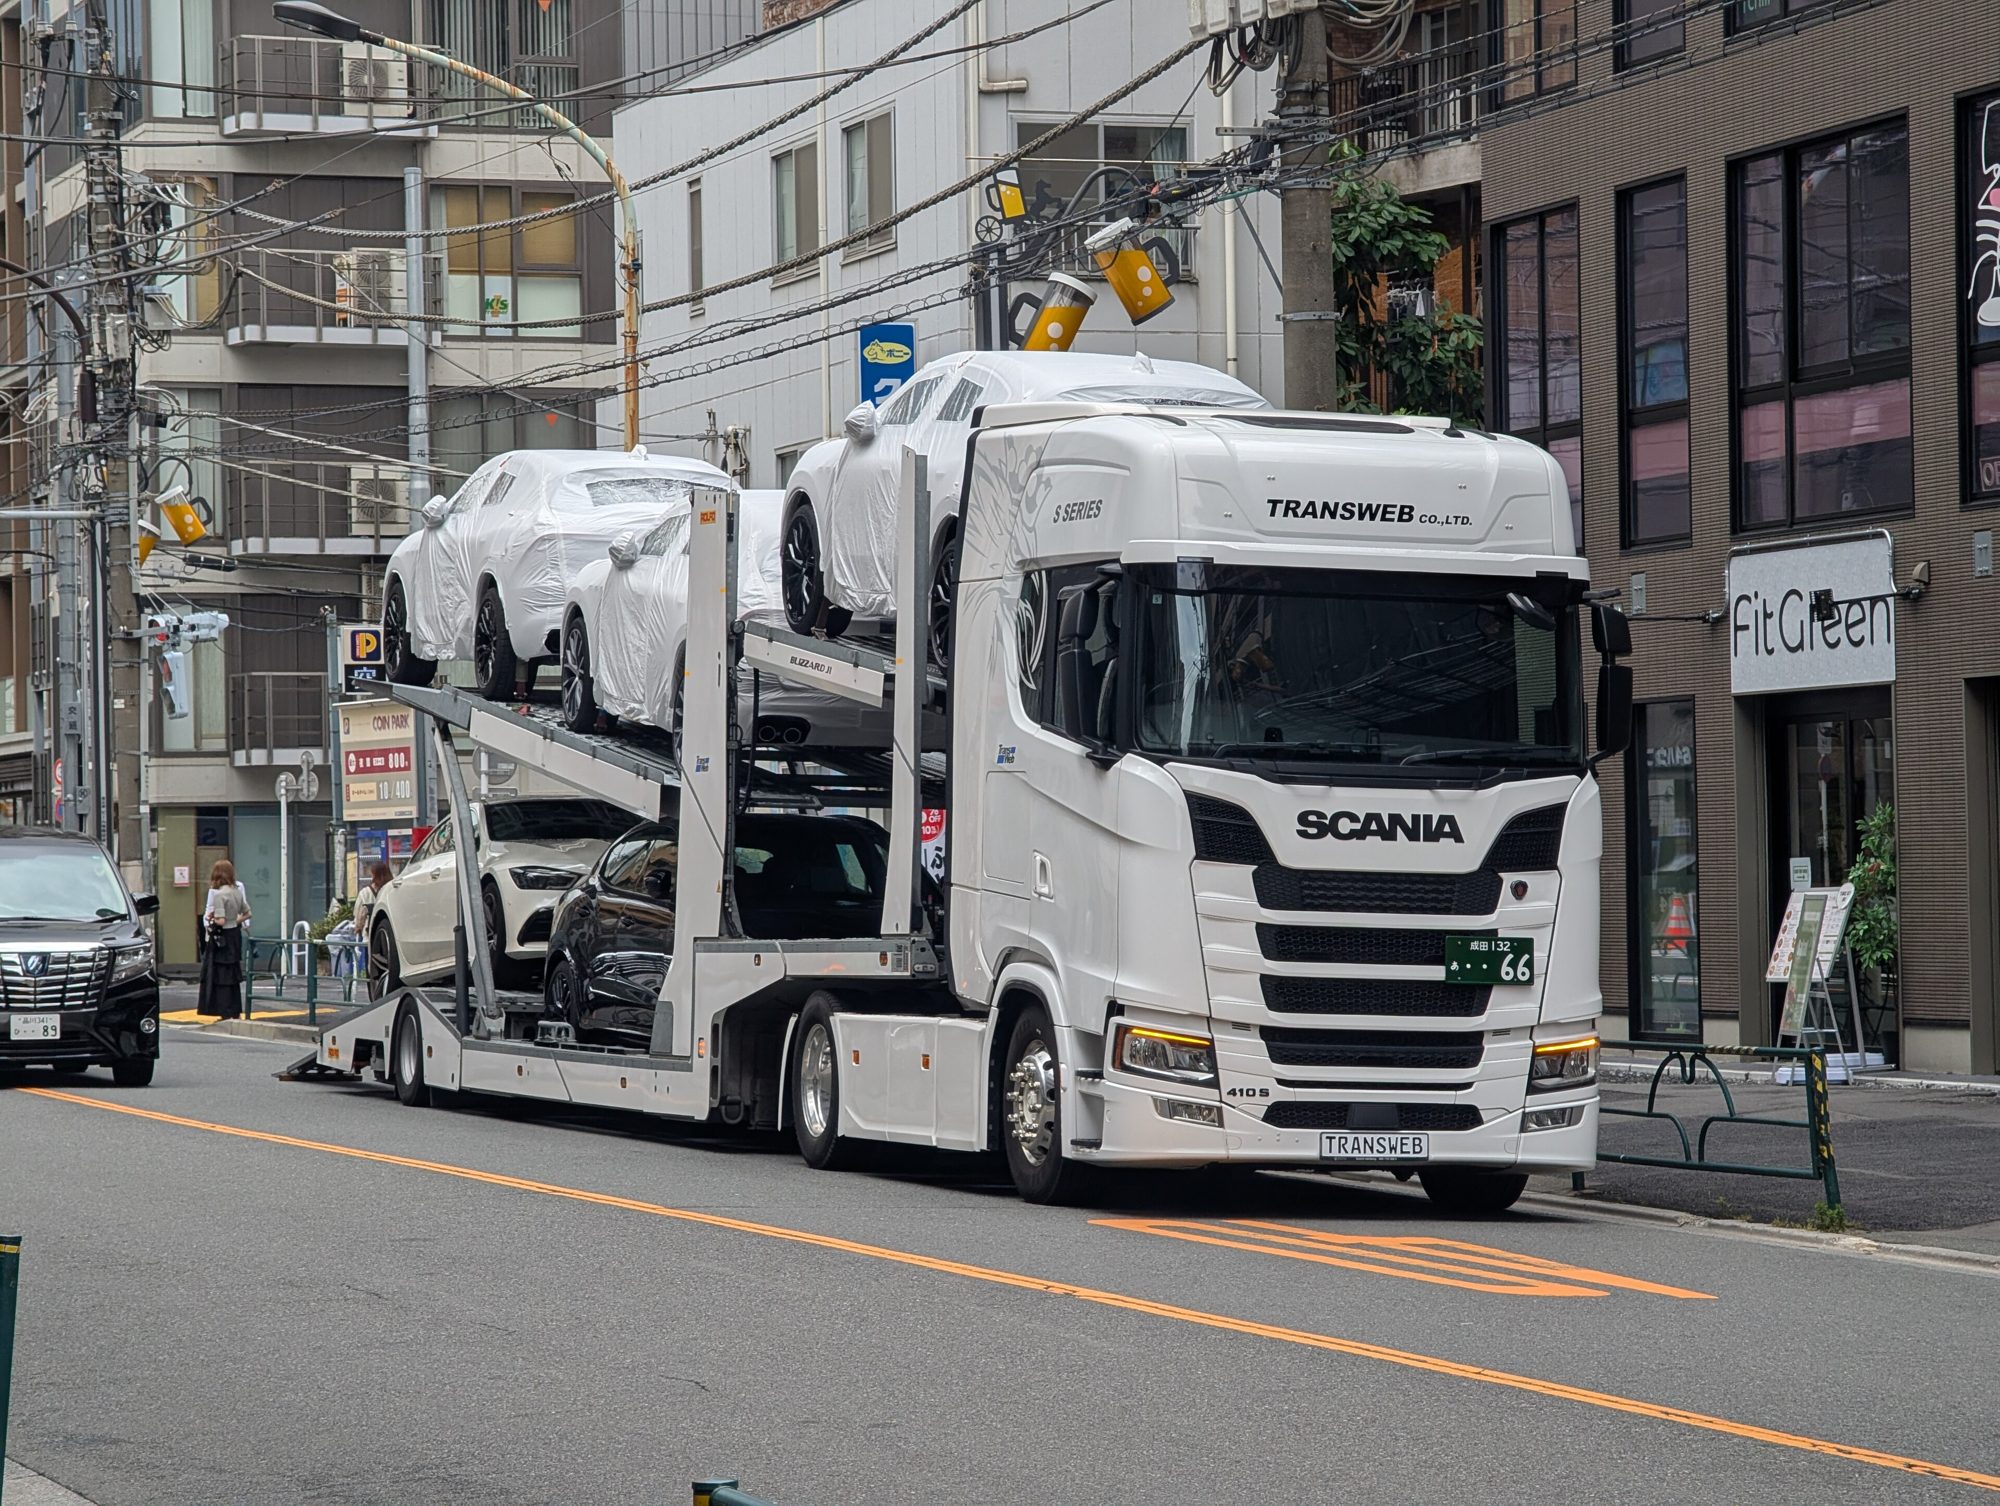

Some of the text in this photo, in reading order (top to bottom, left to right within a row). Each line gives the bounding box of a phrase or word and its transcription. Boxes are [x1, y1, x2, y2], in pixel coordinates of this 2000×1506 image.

[1053, 499, 1103, 524] S SERIES
[1267, 499, 1473, 526] TRANSWEB CO.,LTD.
[790, 656, 826, 672] BLIZZARD
[372, 713, 410, 732] COIN PARK
[388, 752, 405, 769] 800
[1296, 809, 1466, 844] SCANIA
[1470, 941, 1511, 952] 成田 132
[1226, 1088, 1269, 1097] 410 S
[1325, 1135, 1423, 1154] TRANSWEB
